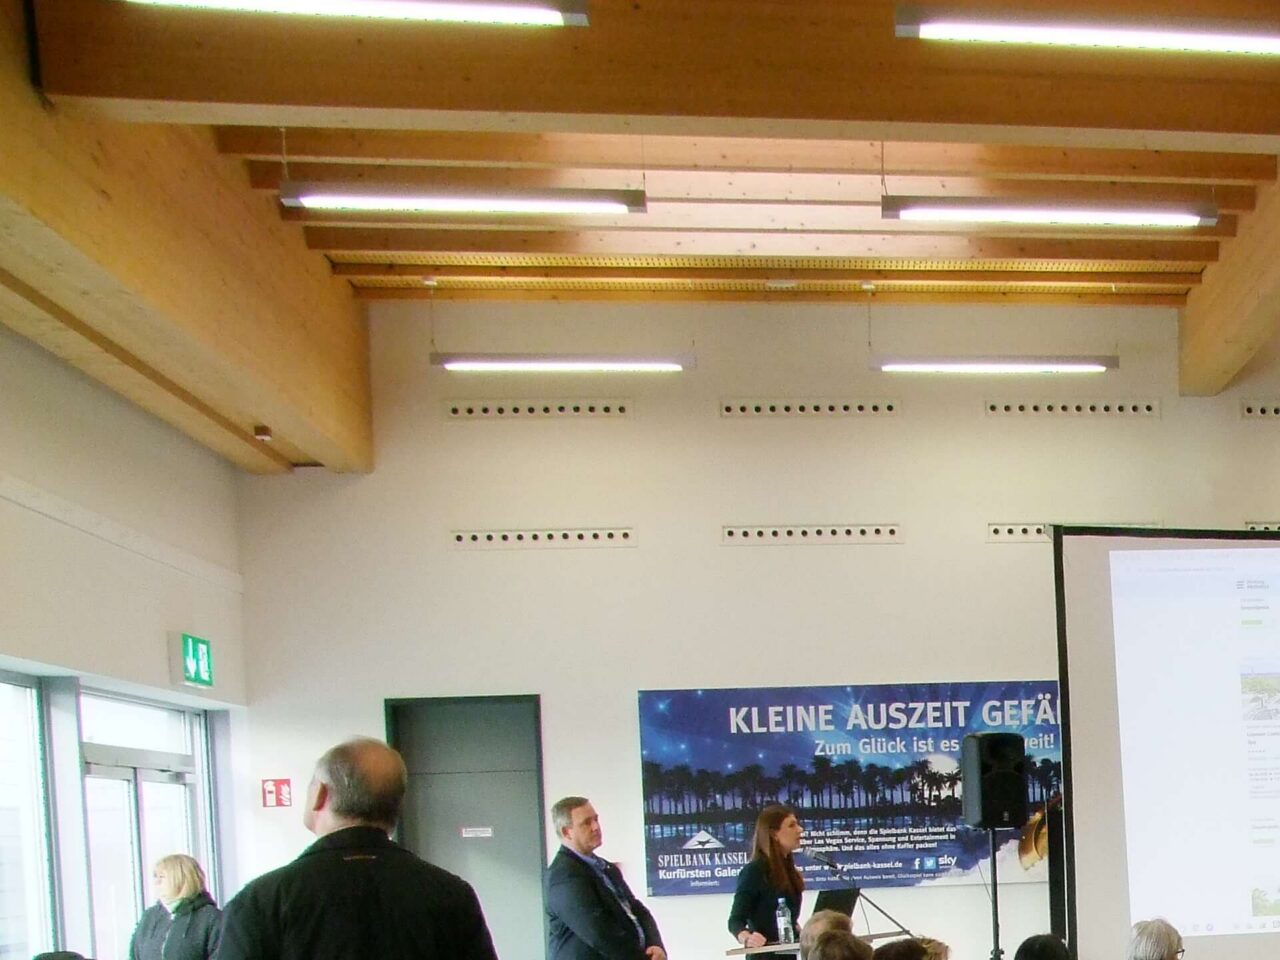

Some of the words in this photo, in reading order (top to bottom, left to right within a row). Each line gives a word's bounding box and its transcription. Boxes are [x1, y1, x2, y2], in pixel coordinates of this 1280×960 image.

[729, 704, 835, 734] KLEINE
[846, 700, 970, 731] AUSZEIT
[814, 740, 851, 756] Zum
[859, 736, 907, 754] Glück
[913, 736, 935, 753] ist
[940, 739, 960, 752] es
[658, 852, 712, 868] SPIELBANK
[715, 851, 750, 866] KASSEL
[938, 853, 958, 866] sky
[658, 868, 711, 880] Kurfürsten
